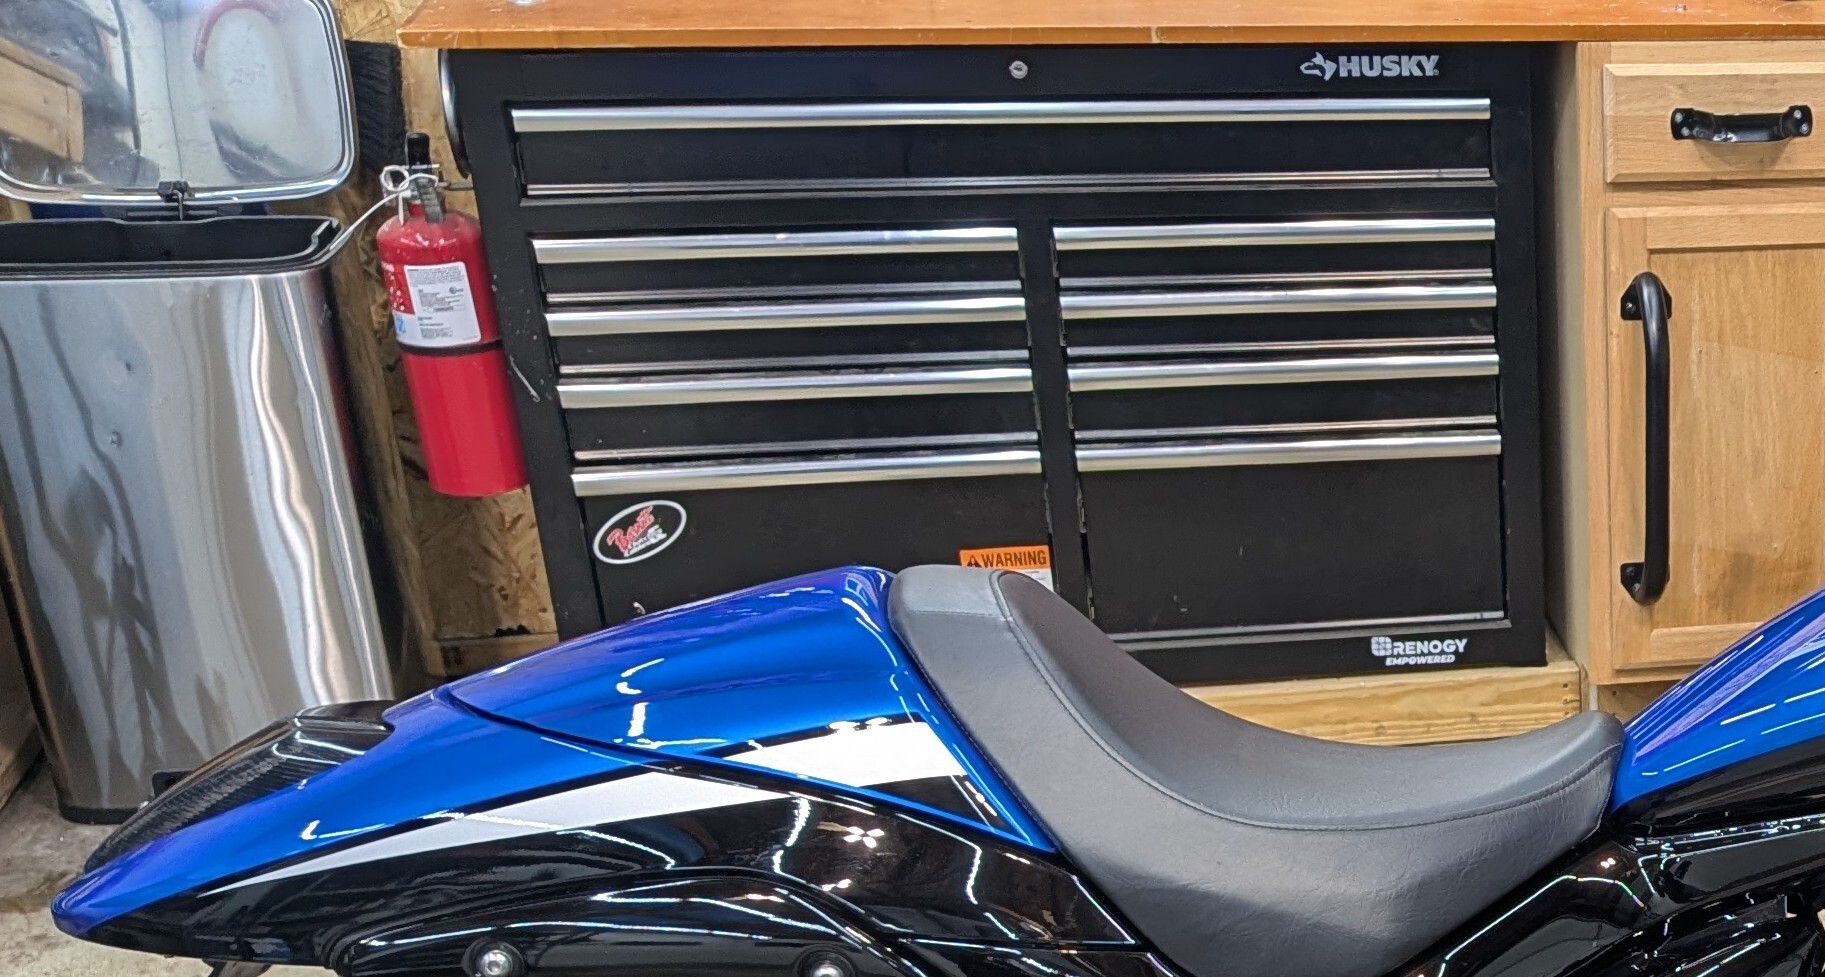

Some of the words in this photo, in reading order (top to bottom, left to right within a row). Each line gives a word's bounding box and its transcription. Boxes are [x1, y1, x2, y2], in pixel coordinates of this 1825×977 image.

[1338, 55, 1439, 77] HUSKY
[981, 550, 1047, 568] WARNING
[1393, 638, 1468, 656] RENOGY
[1385, 654, 1456, 667] EMPOWERED
